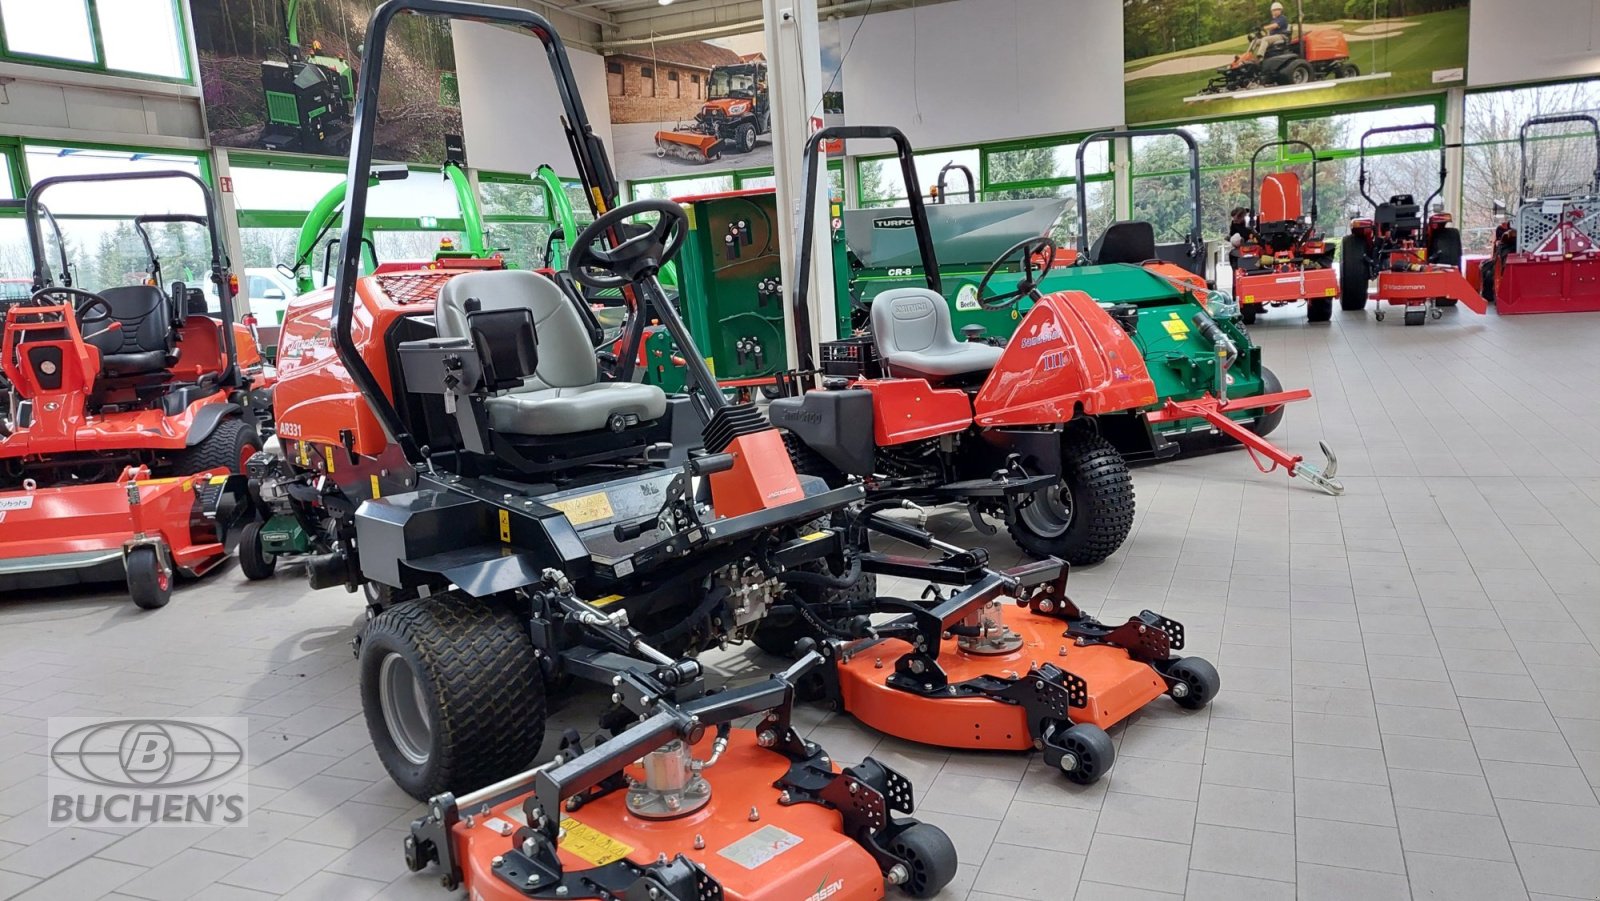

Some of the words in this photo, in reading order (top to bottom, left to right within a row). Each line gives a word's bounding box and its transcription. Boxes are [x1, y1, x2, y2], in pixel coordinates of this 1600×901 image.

[876, 219, 914, 227] TURFC
[888, 268, 912, 276] CR-8
[279, 422, 302, 437] AR331
